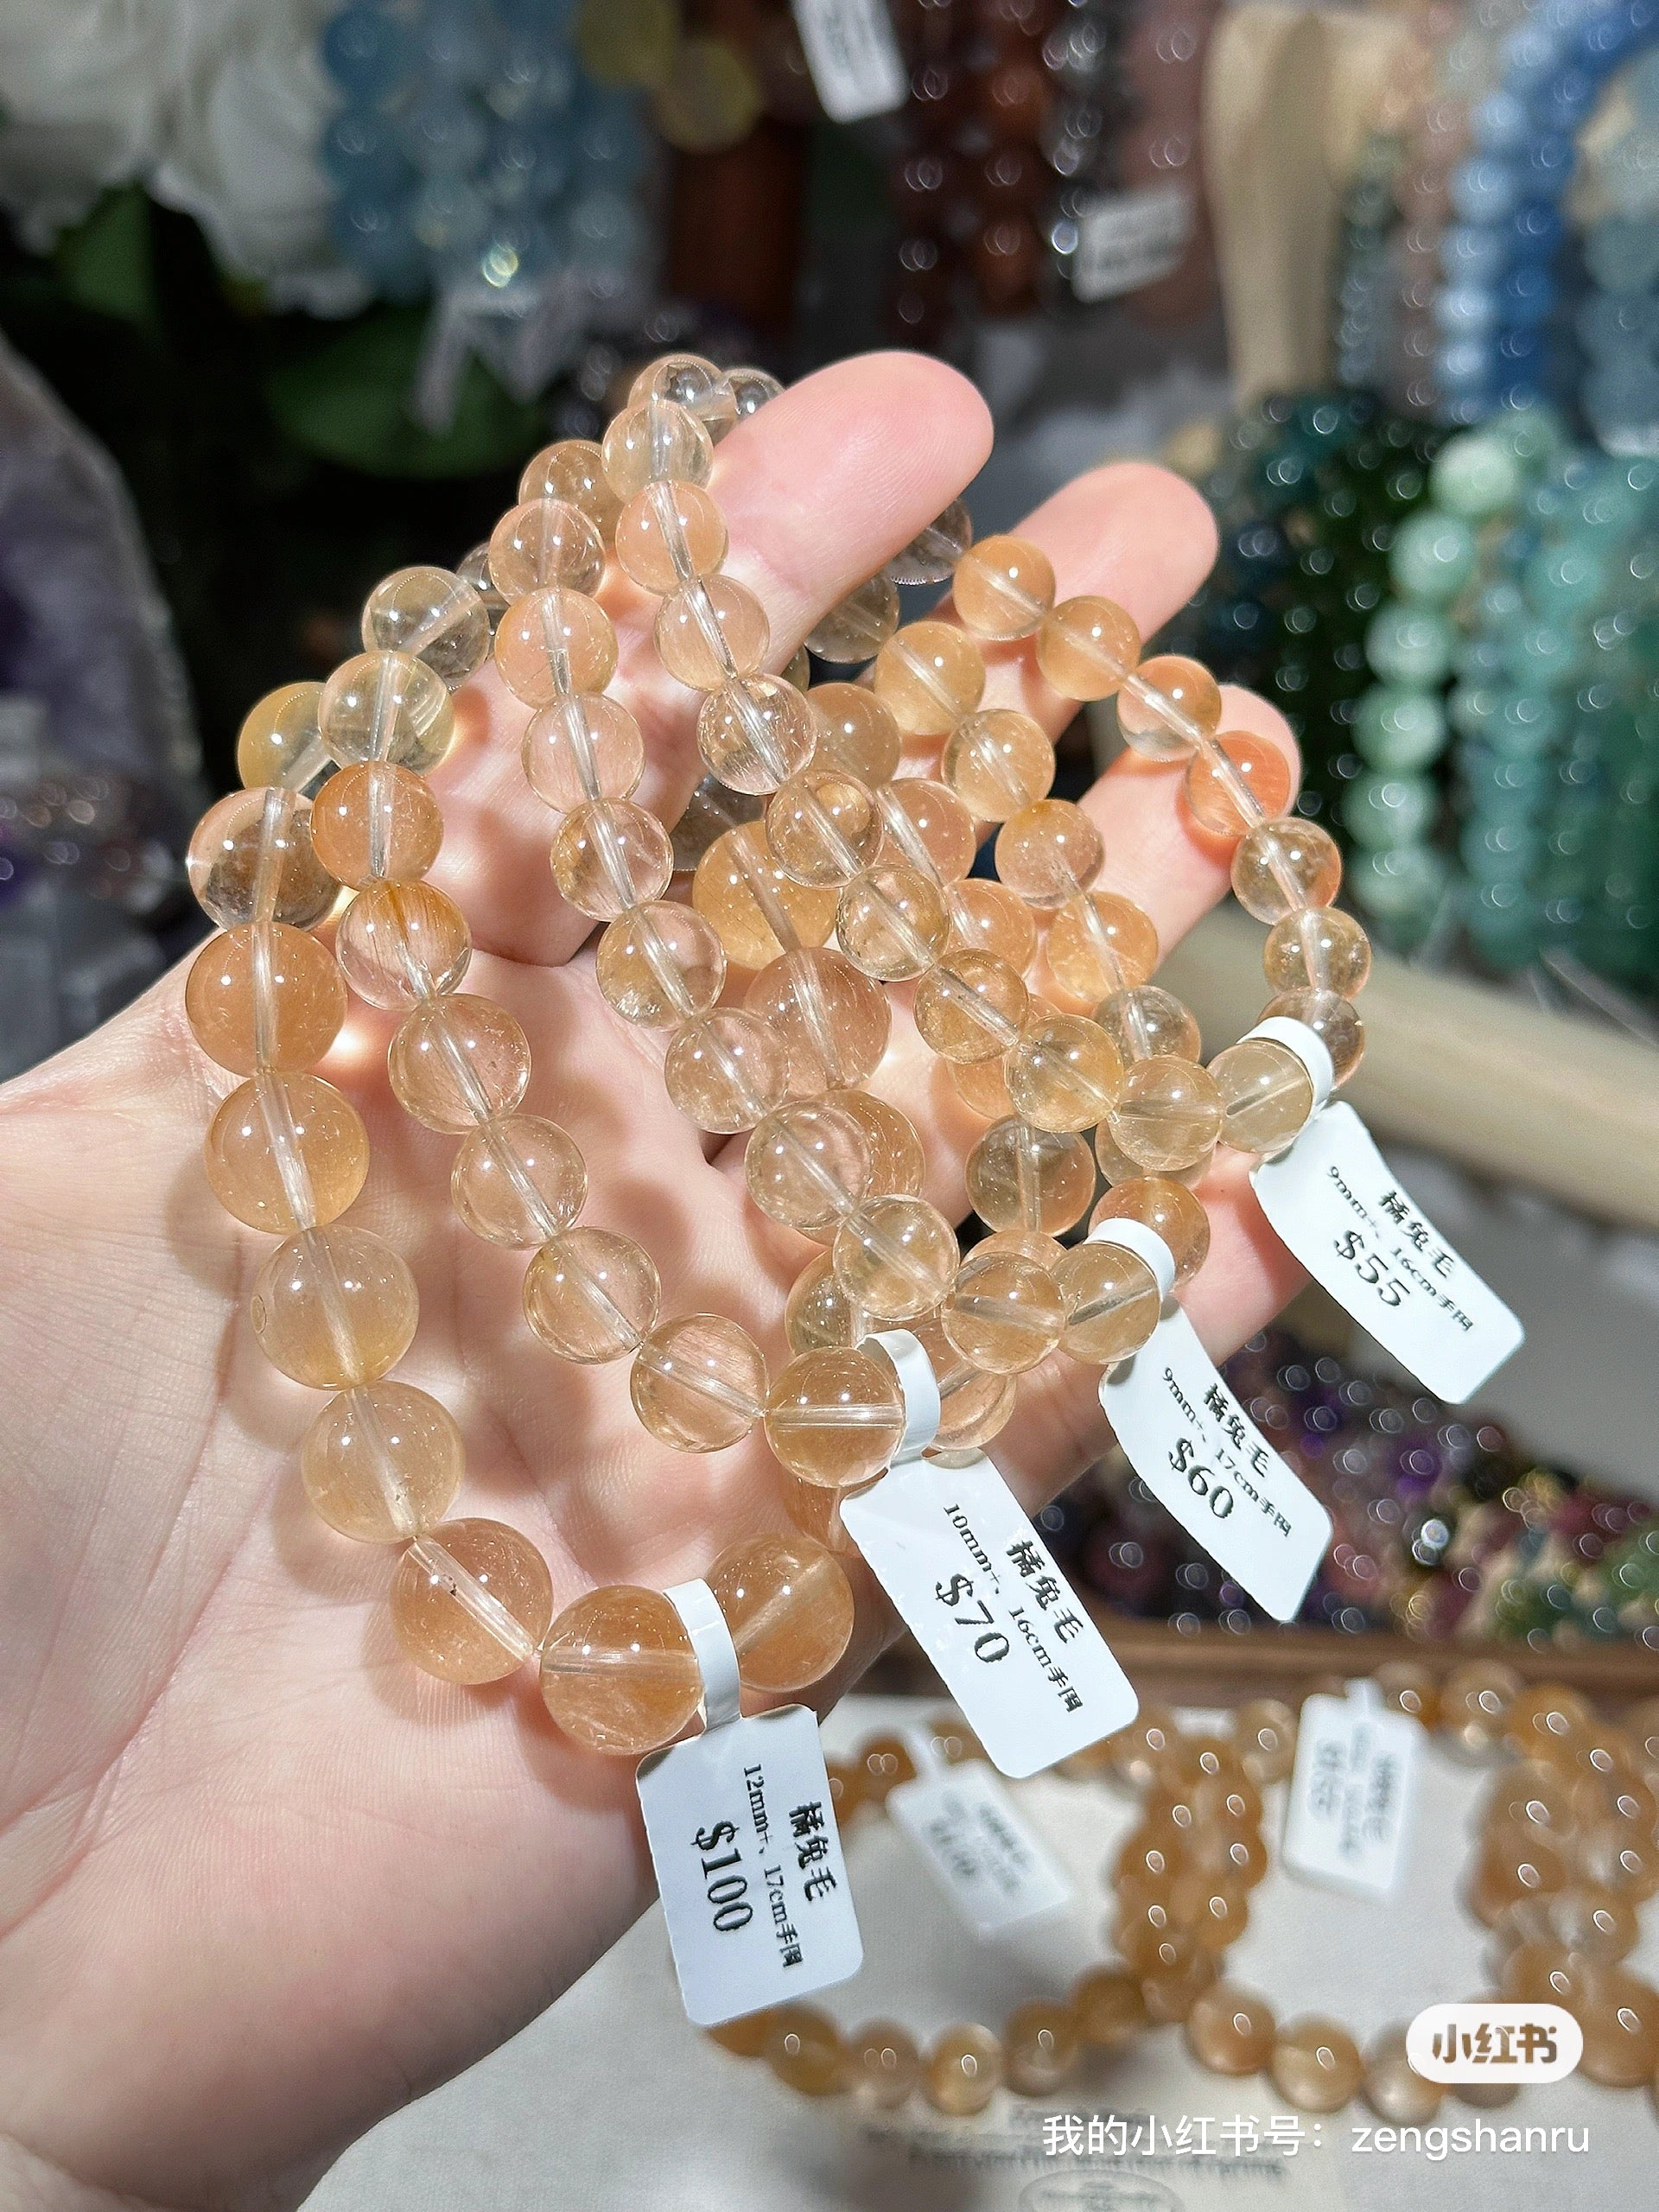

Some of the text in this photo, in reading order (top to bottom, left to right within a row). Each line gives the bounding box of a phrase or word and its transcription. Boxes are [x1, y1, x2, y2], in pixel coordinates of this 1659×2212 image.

[1333, 1230, 1411, 1307] $55
[1168, 1437, 1235, 1519] $60
[934, 1573, 1010, 1664] $70
[1005, 1540, 1084, 1644] 橘兔毛
[690, 1820, 753, 1932] $100
[788, 1800, 837, 1903] 橘兔毛
